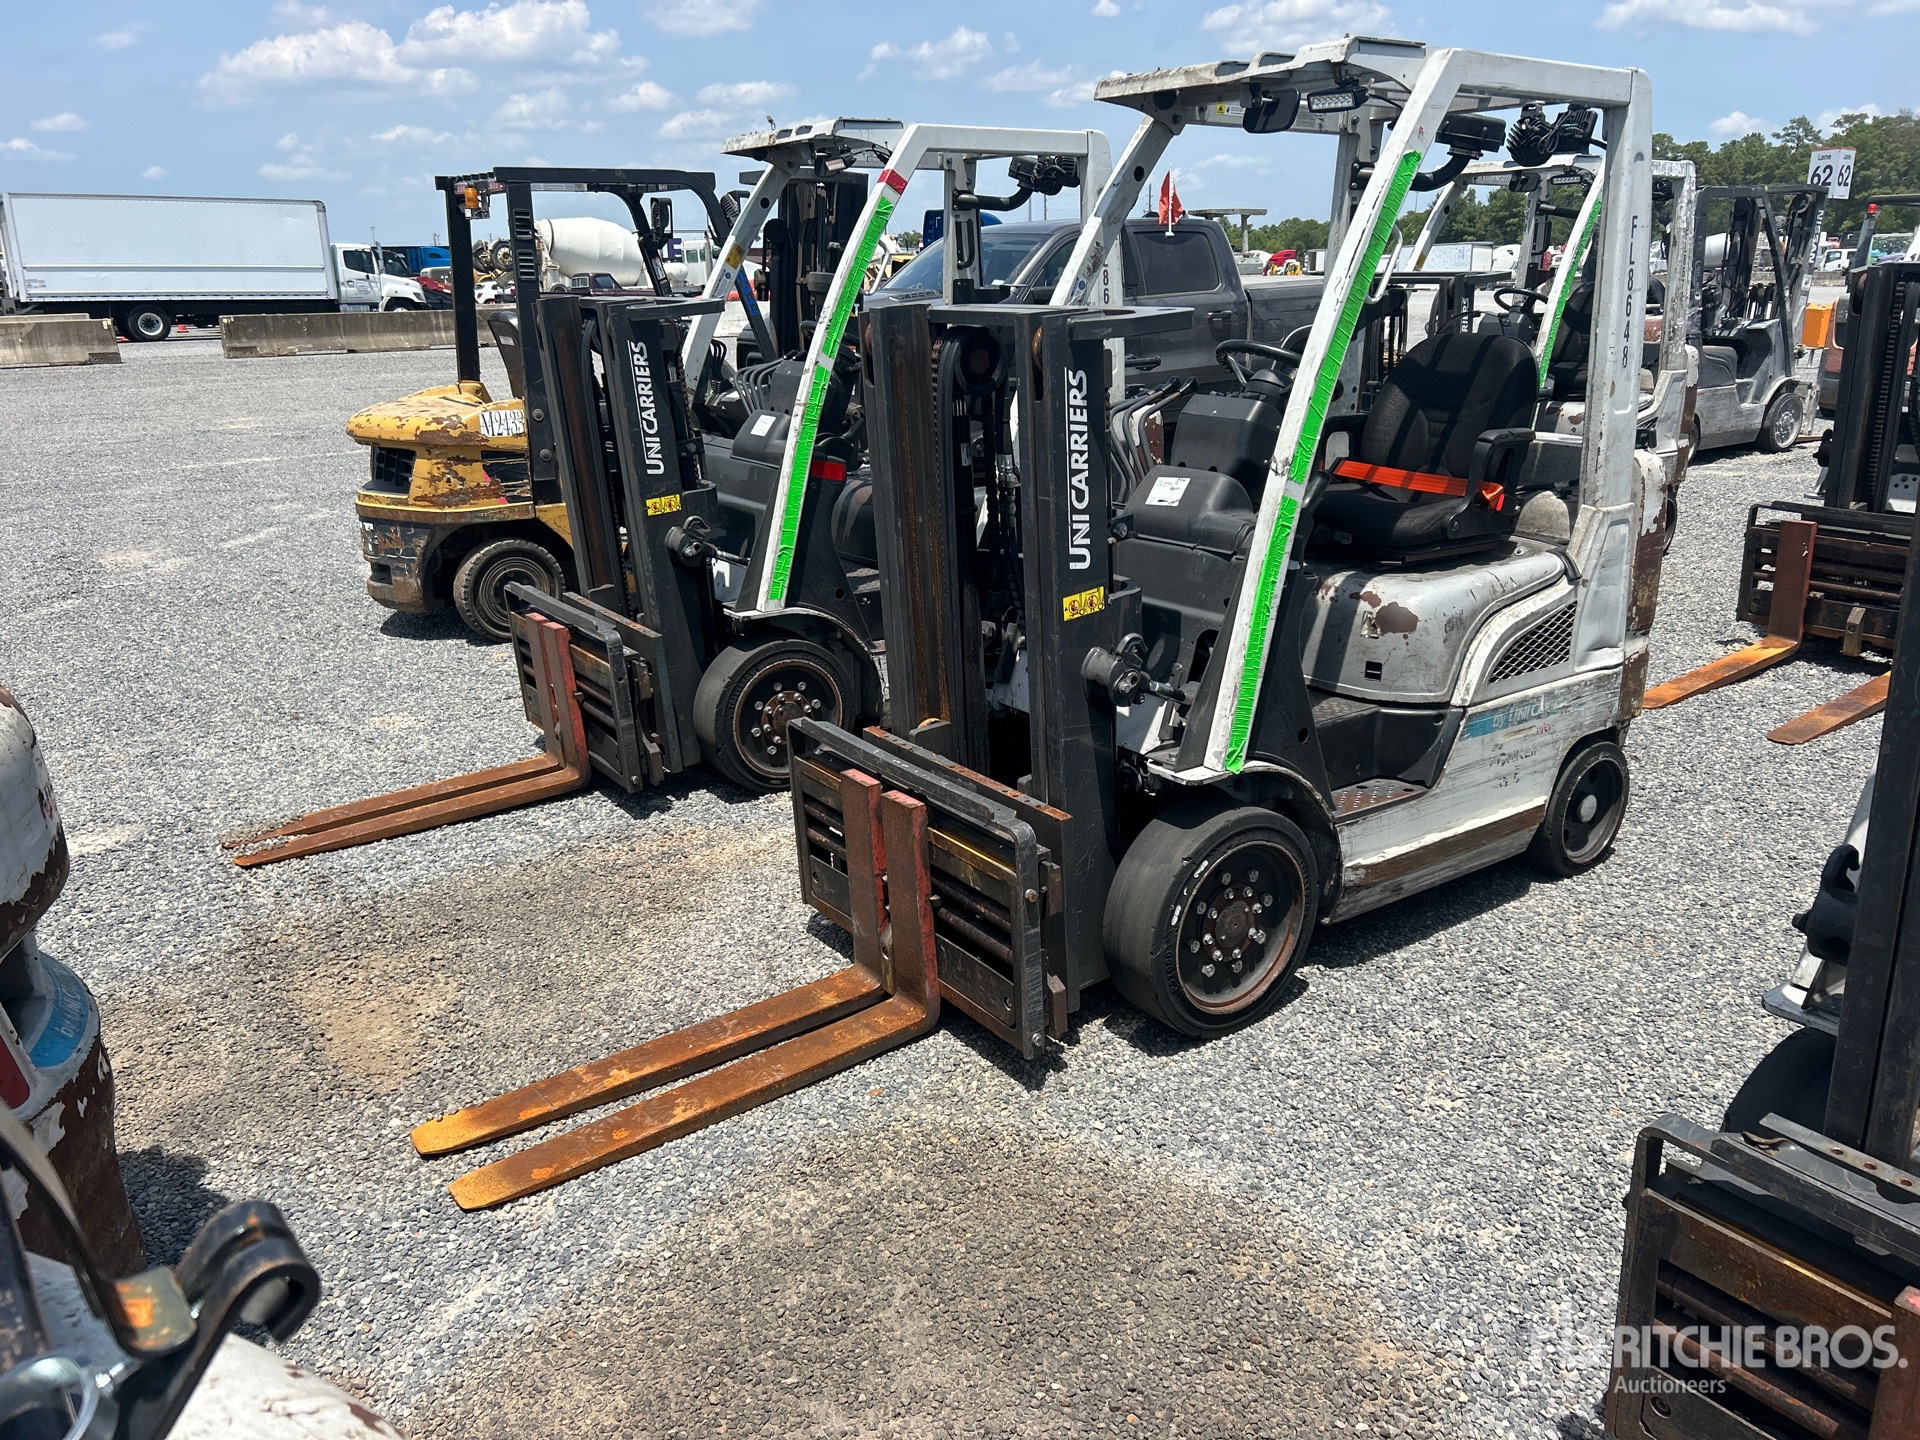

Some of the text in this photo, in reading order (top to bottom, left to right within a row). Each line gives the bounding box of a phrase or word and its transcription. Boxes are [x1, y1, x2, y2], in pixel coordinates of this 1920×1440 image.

[1810, 164, 1834, 187] 62
[1837, 164, 1851, 187] 62
[1808, 209, 1825, 264] NISSAN
[627, 340, 665, 475] UNICARRIERS
[1064, 366, 1092, 570] UNICARRIERS
